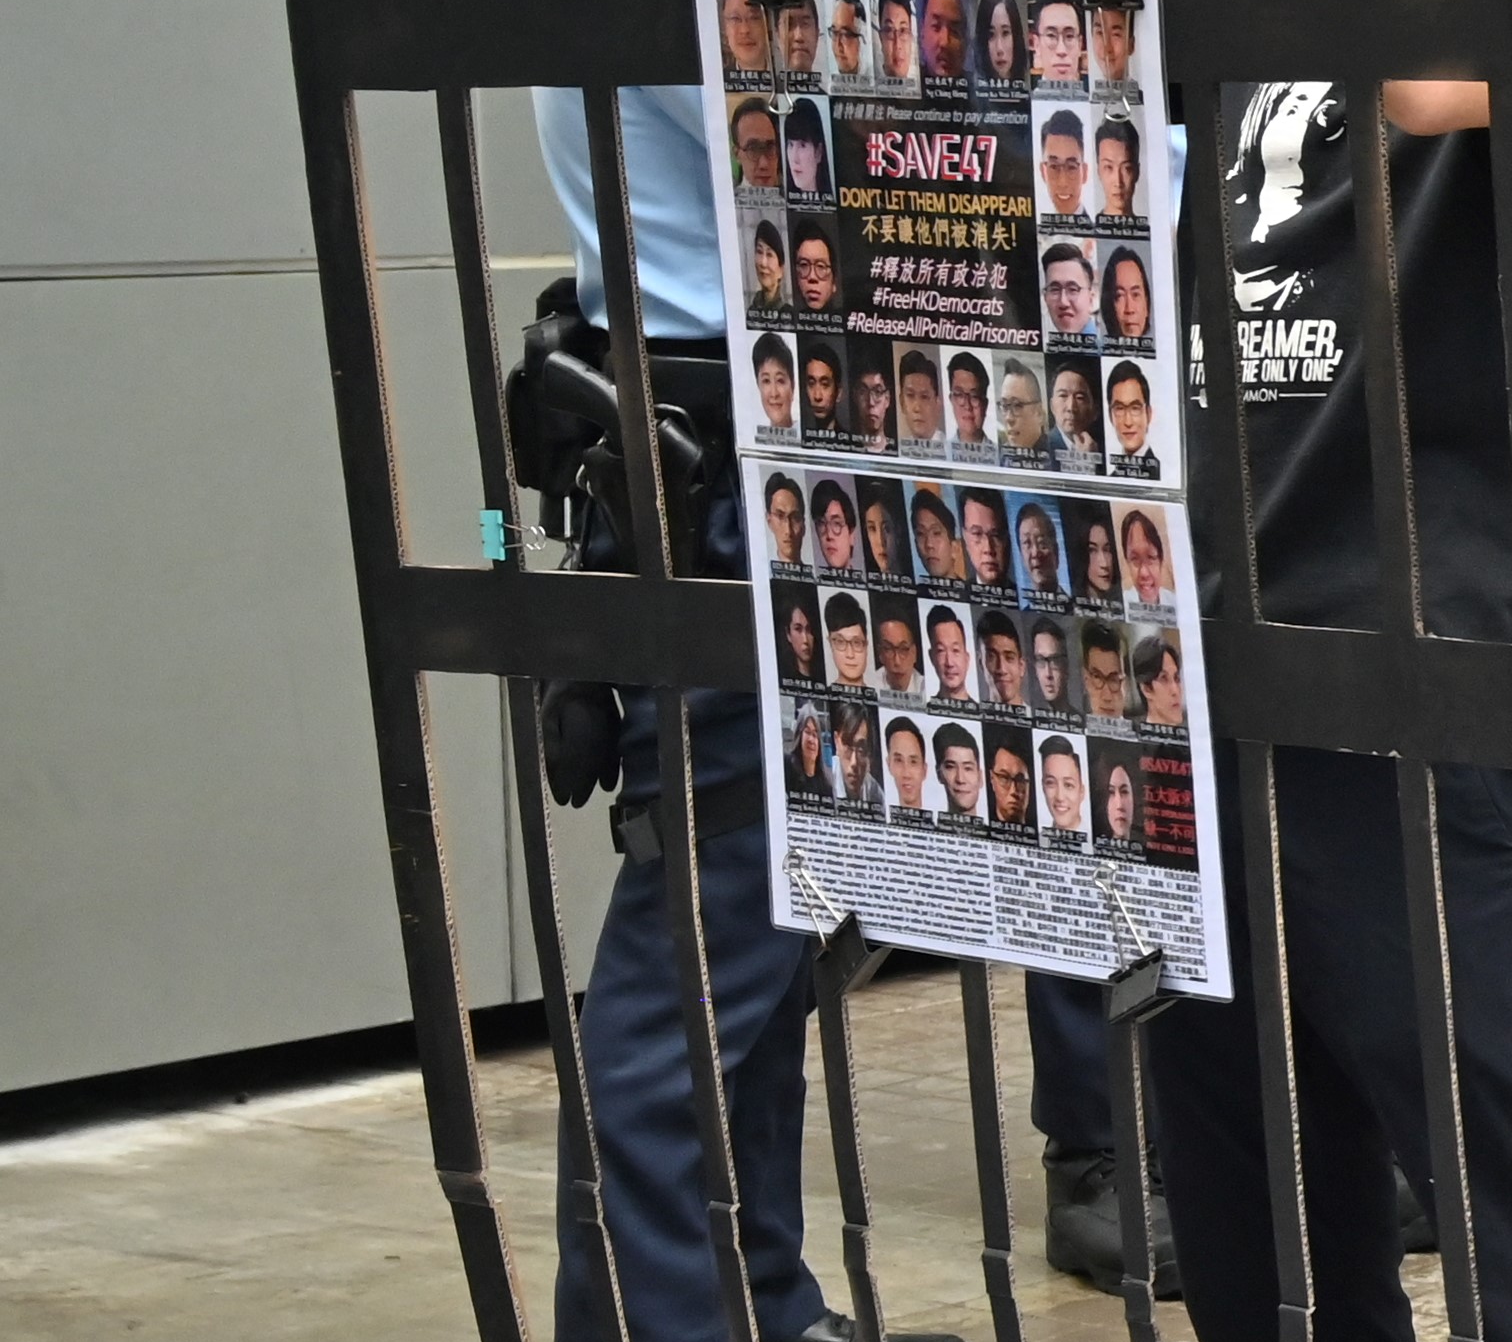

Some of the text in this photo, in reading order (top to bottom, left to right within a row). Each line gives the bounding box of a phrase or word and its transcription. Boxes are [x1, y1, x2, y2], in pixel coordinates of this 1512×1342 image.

[886, 107, 913, 120] Please
[913, 108, 952, 122] continue
[953, 110, 963, 122] to
[964, 112, 980, 126] pay
[983, 110, 1029, 125] attention
[866, 130, 998, 183] #SAVE47
[839, 186, 882, 208] DON'T
[884, 188, 906, 210] LET
[908, 188, 945, 212] THEM
[949, 193, 1032, 217] DISAPPEAR!
[872, 286, 1005, 316] #FreeHKDemocrats
[846, 311, 1040, 347] #ReleaseAllPoliticalPrisoners
[1237, 319, 1344, 366] REAMER,
[1261, 359, 1299, 383] ONLY
[1302, 359, 1335, 382] ONE
